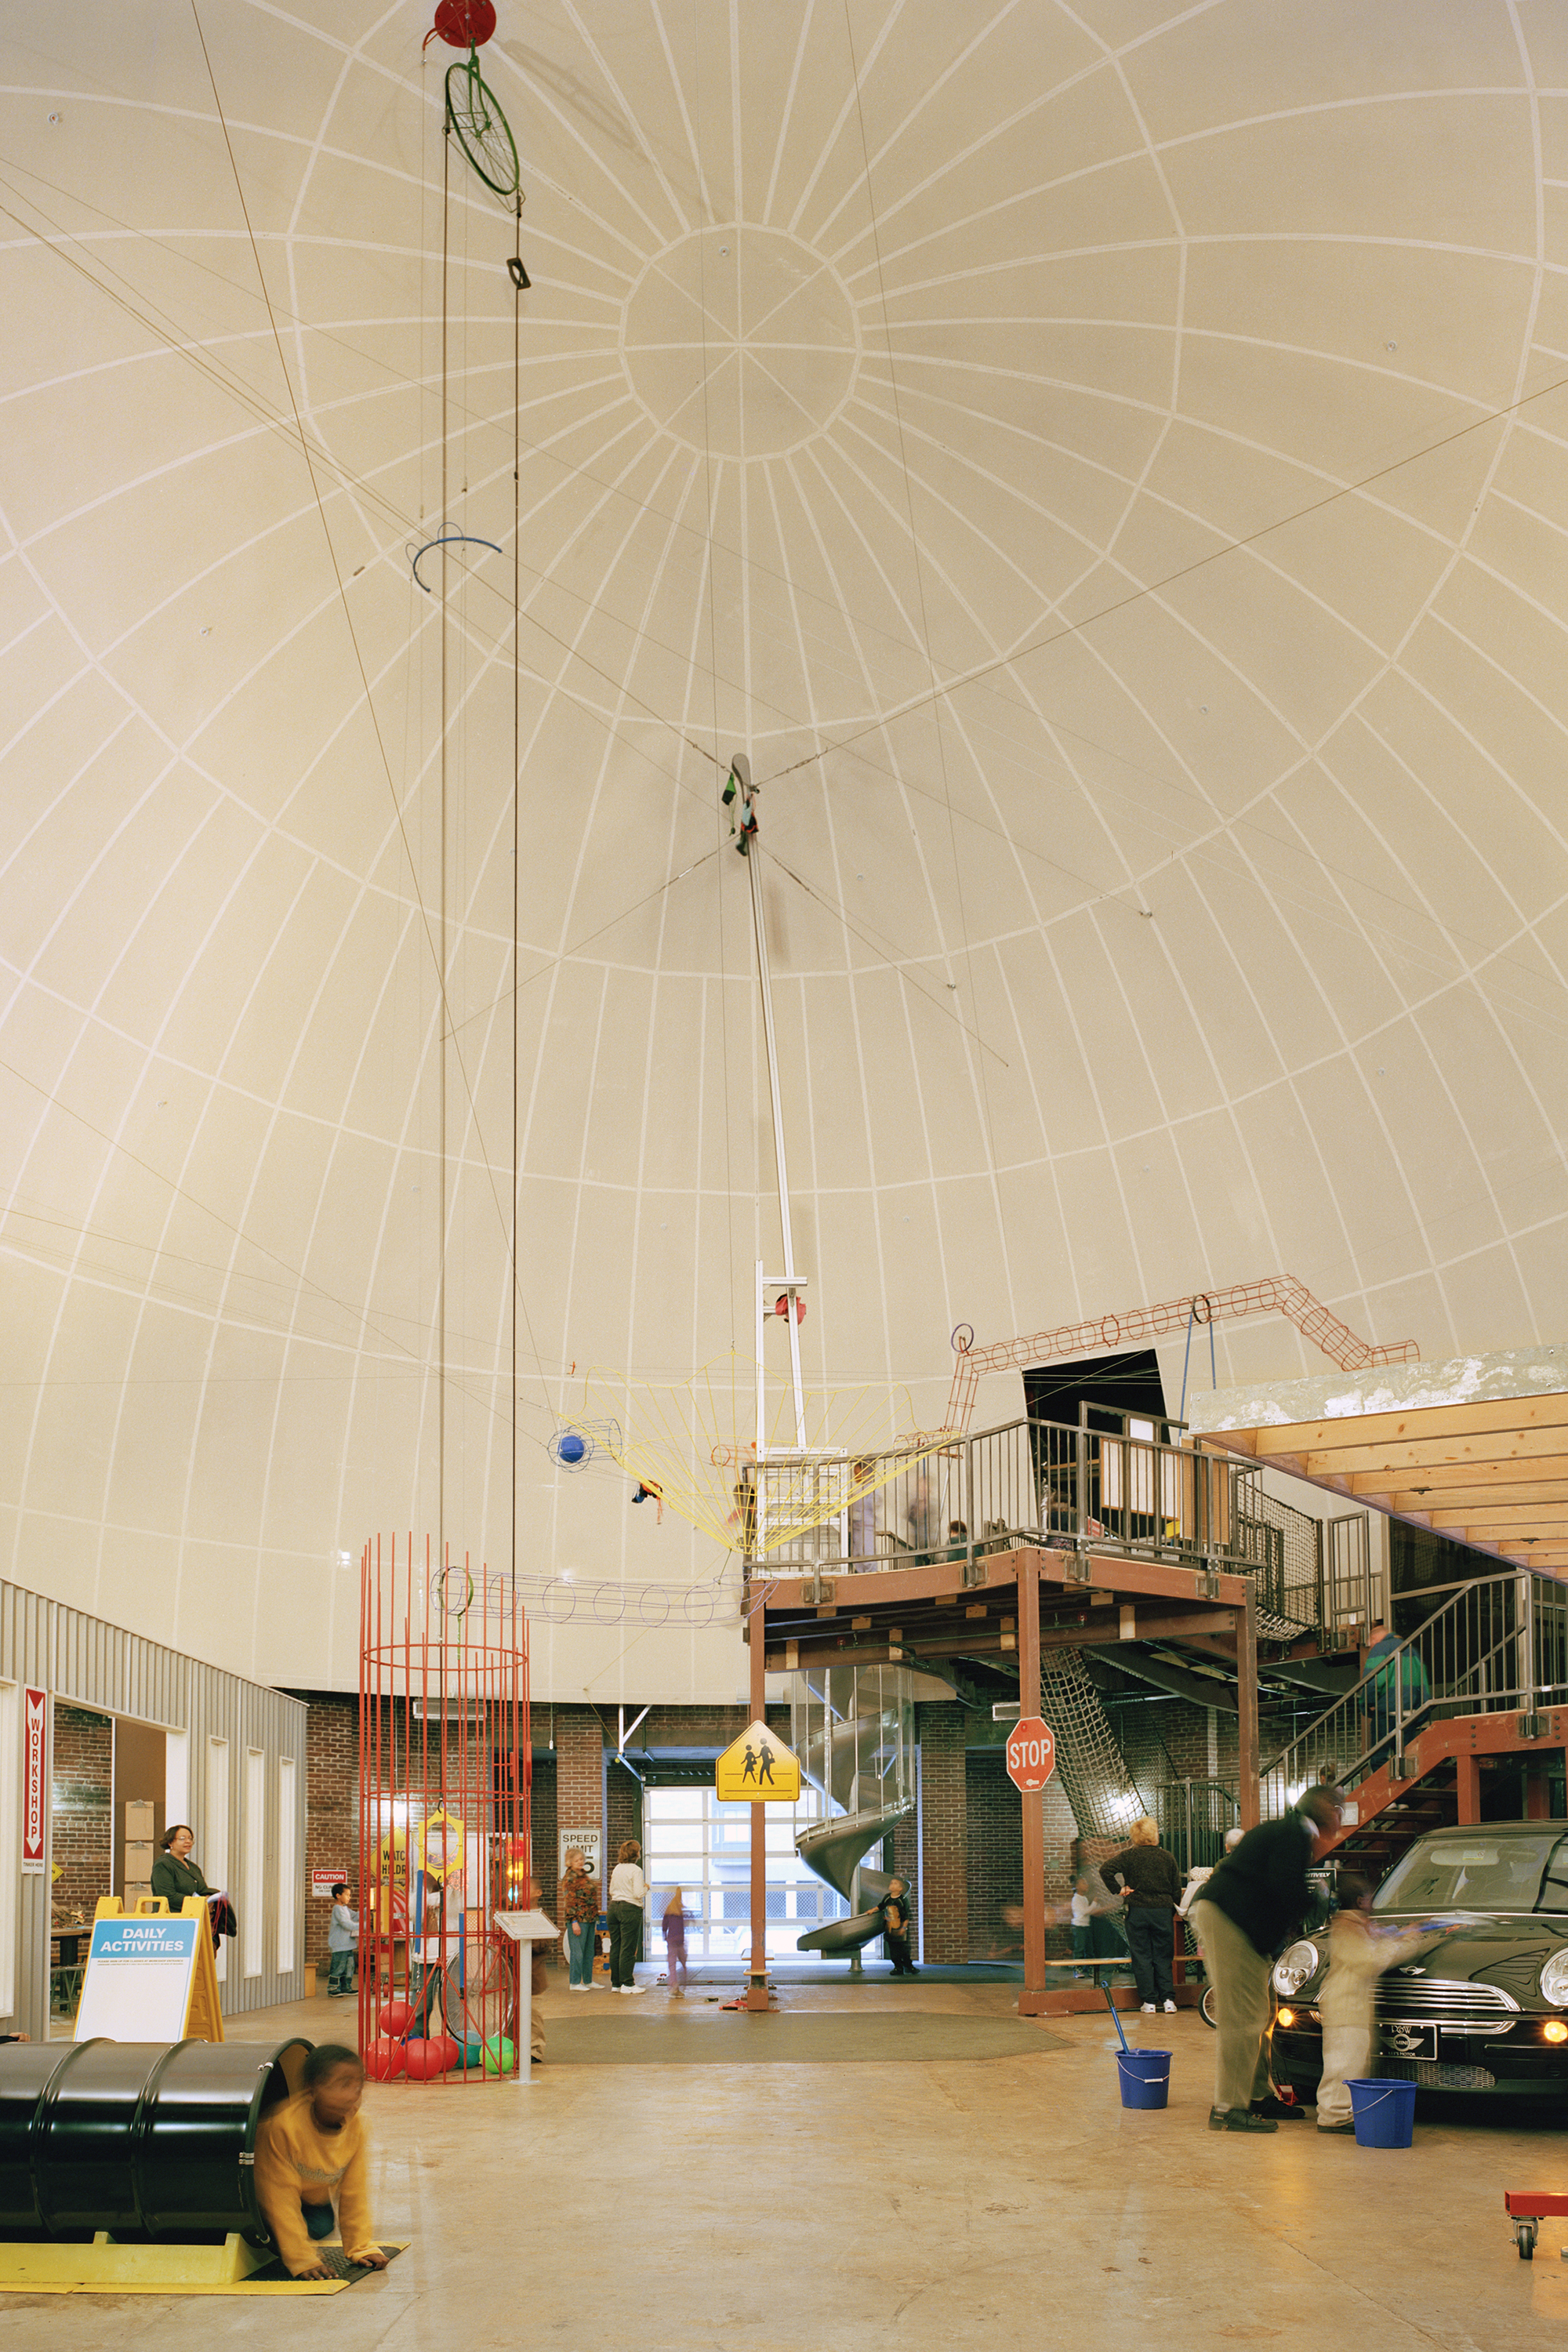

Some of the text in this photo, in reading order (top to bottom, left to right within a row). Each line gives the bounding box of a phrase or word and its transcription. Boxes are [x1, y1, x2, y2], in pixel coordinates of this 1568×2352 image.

[1010, 1739, 1051, 1769] STOP
[31, 1718, 40, 1838] WORKSHOP
[383, 1850, 405, 1861] WTC
[122, 1928, 167, 1939] DAILY
[100, 1940, 184, 1951] ACTIVITIES
